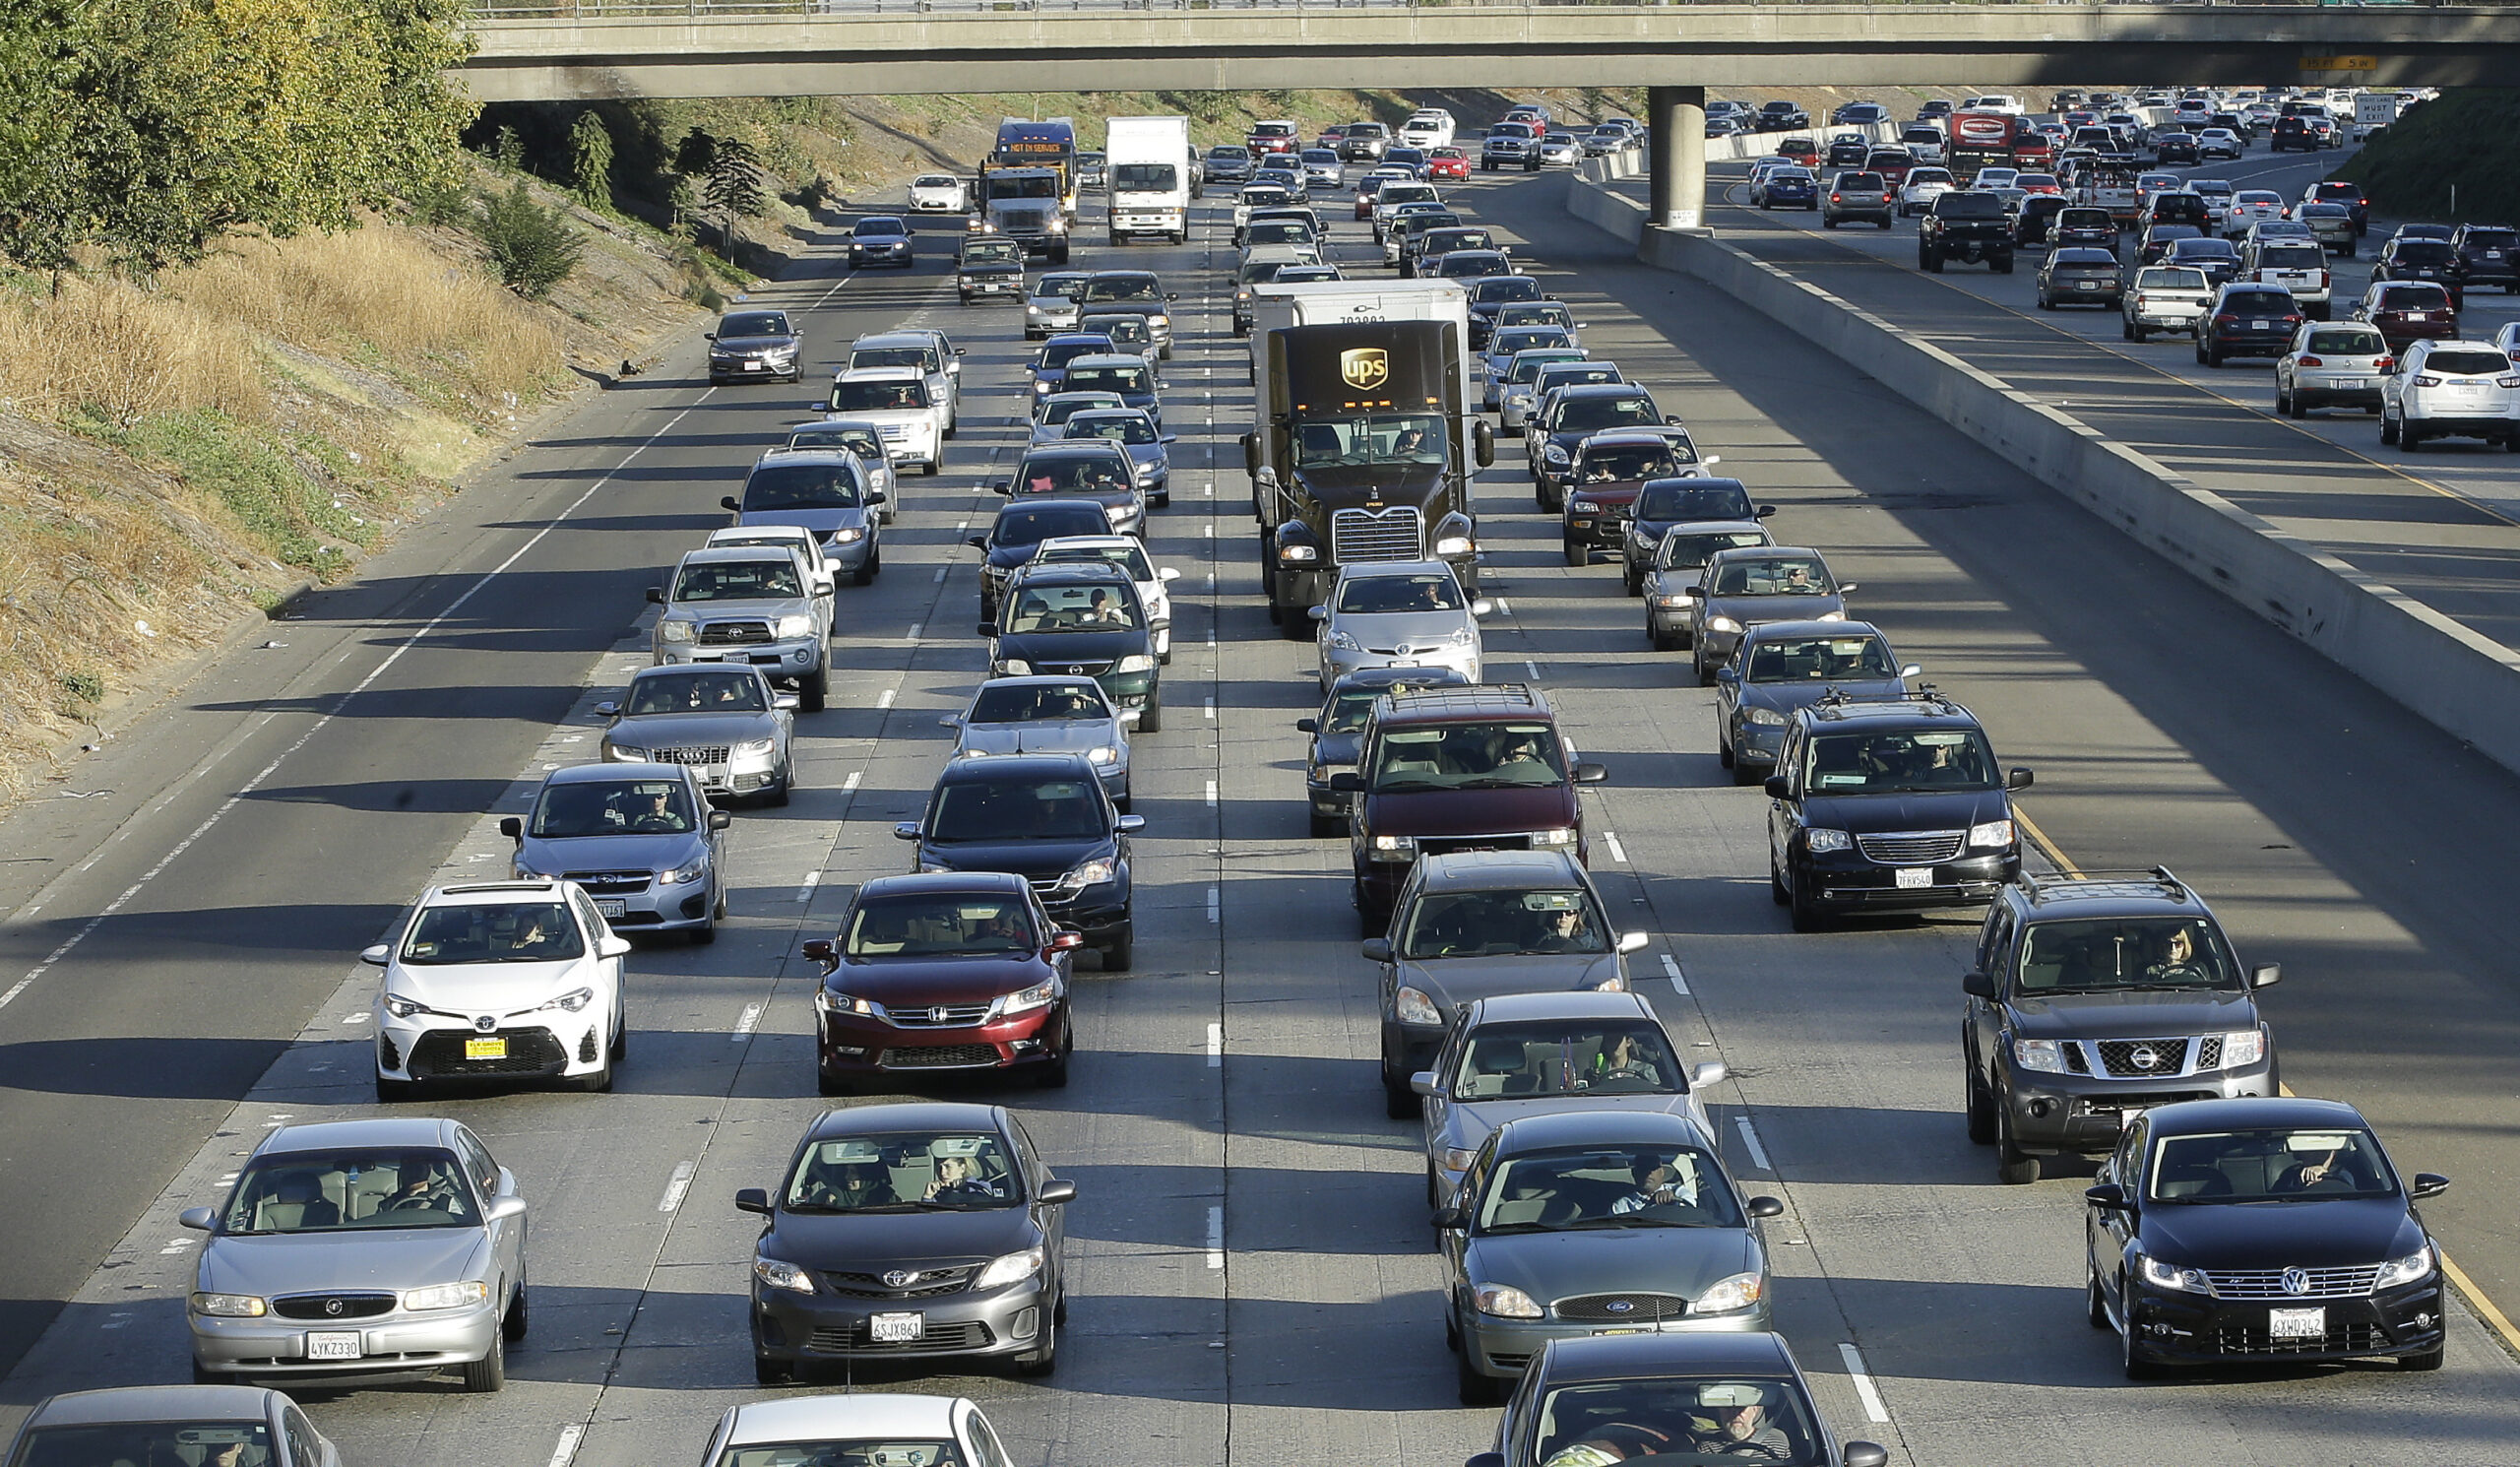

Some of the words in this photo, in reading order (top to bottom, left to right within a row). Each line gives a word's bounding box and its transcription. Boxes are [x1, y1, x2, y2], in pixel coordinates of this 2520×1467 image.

[1010, 143, 1024, 153] NOT
[1025, 143, 1033, 153] IN
[1034, 143, 1061, 153] SERVICE
[1345, 359, 1386, 384] ups
[874, 1322, 919, 1337] 6SJX861
[311, 1342, 357, 1355] 4YKZ330
